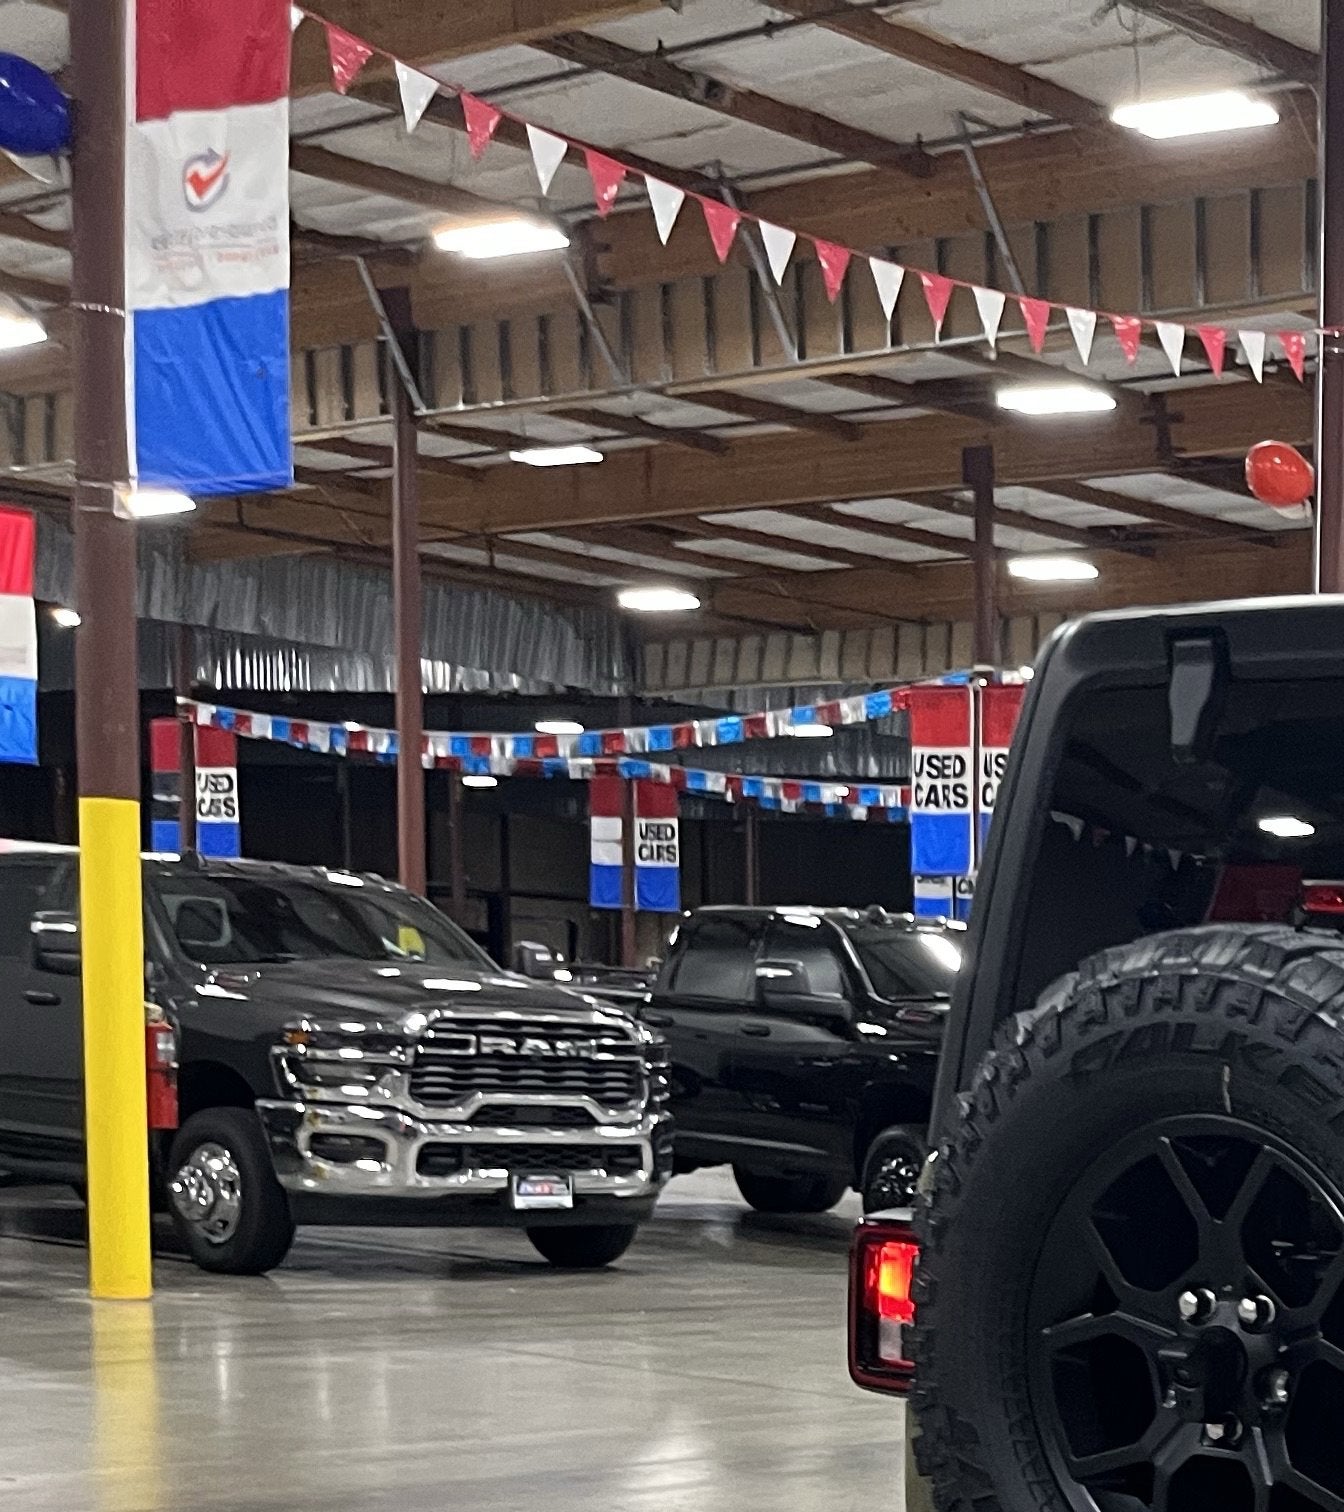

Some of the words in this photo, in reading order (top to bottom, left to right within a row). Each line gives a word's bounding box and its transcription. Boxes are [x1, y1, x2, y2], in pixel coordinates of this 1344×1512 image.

[914, 753, 966, 779] USED
[983, 753, 1009, 777] US
[914, 782, 969, 809] CARS
[639, 822, 676, 841] USED
[480, 1035, 597, 1060] RAM
